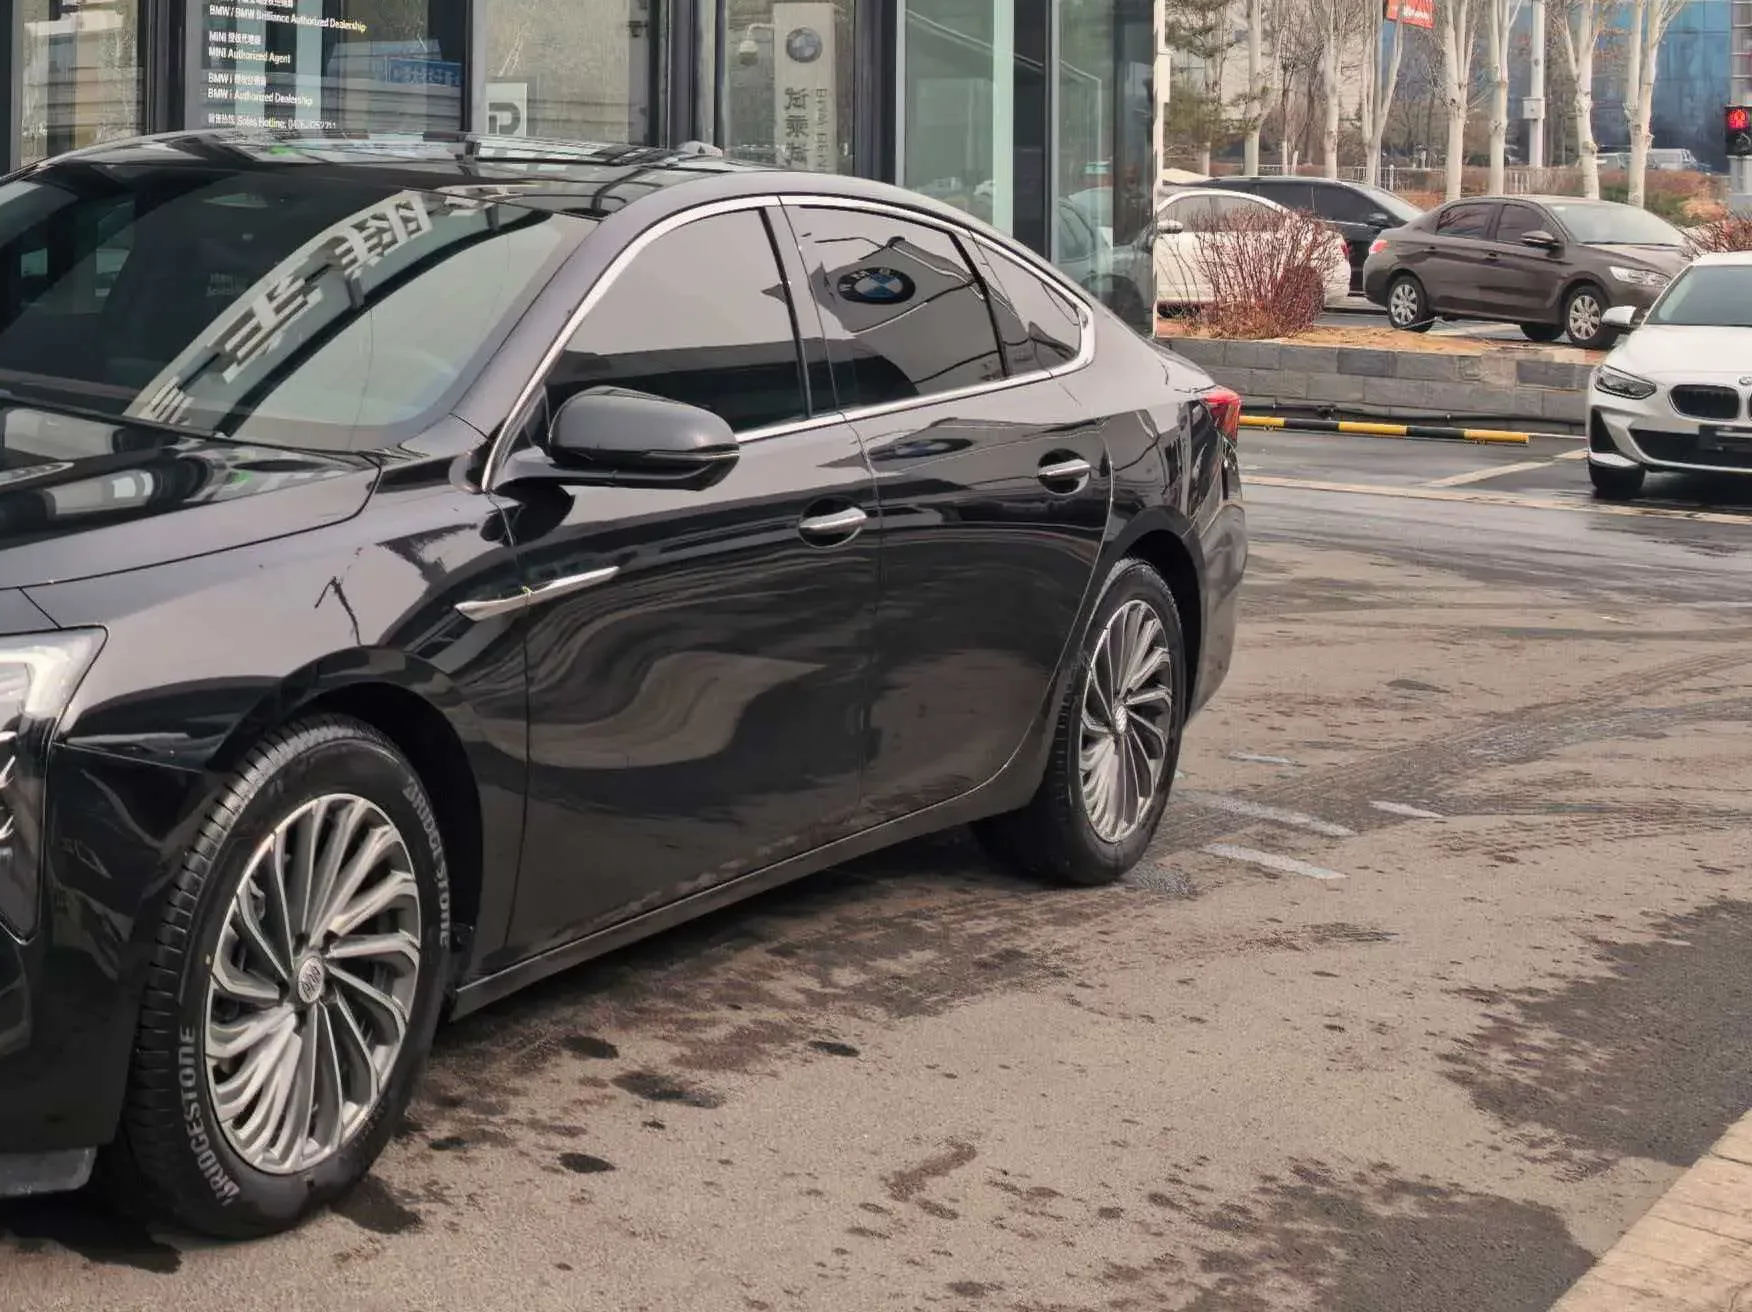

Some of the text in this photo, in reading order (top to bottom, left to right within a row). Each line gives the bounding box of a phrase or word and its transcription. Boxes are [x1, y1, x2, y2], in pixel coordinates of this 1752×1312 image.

[209, 5, 230, 16] BMW
[235, 7, 255, 20] BMW
[329, 18, 367, 33] Dealership
[209, 31, 227, 43] MINI
[208, 46, 226, 58] MINI
[269, 53, 291, 64] Agent
[208, 72, 229, 84] BMW
[208, 88, 228, 99] BMW
[274, 92, 313, 106] Dealership
[401, 776, 451, 950] BRIDGESTONE
[178, 1024, 241, 1207] BRIDGESTONE
